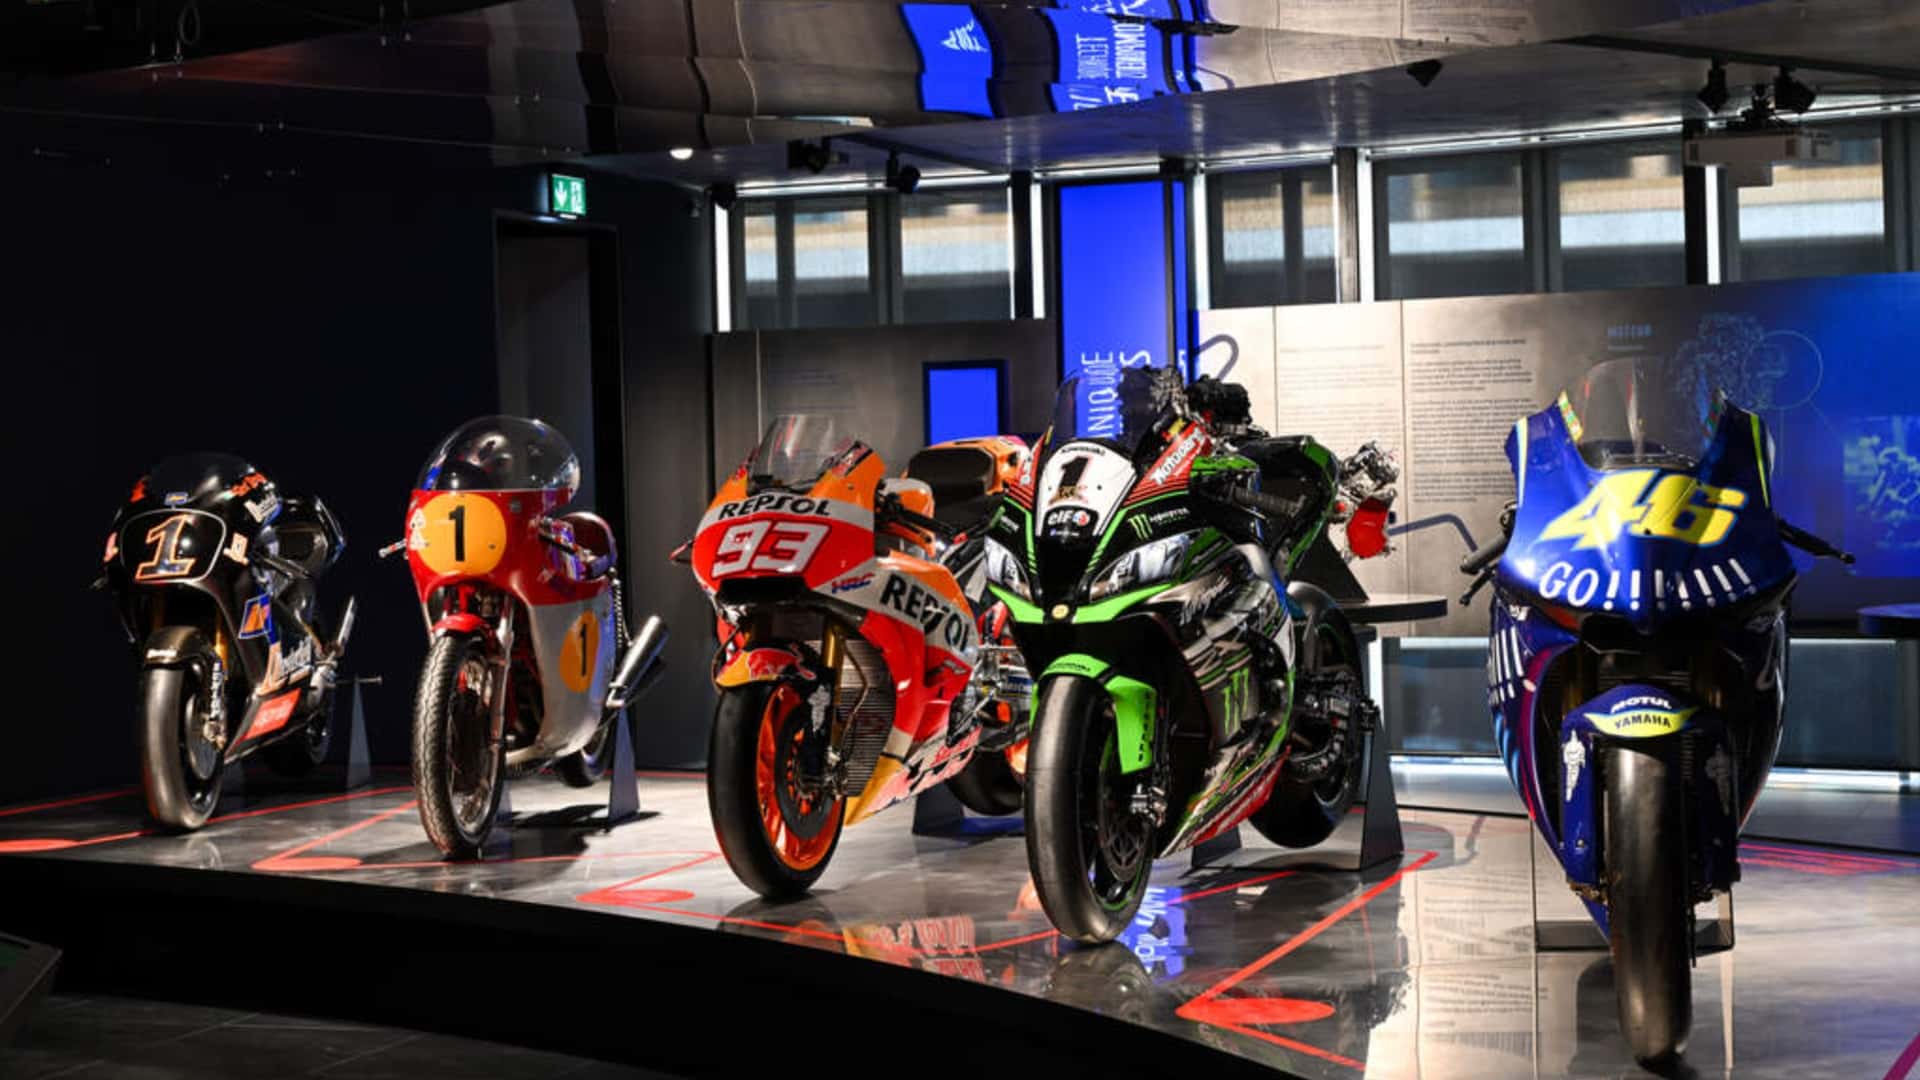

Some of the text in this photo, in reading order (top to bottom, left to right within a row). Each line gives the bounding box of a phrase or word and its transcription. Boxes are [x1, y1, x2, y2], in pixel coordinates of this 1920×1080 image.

[1060, 455, 1091, 487] 1
[449, 505, 465, 562] 1
[718, 494, 831, 521] REPSOL
[1536, 468, 1748, 551] 46
[136, 513, 196, 580] 1
[711, 520, 830, 579] 93
[579, 622, 588, 678] 1
[1610, 696, 1672, 714] MOTUL
[1614, 713, 1672, 729] YAMAHA
